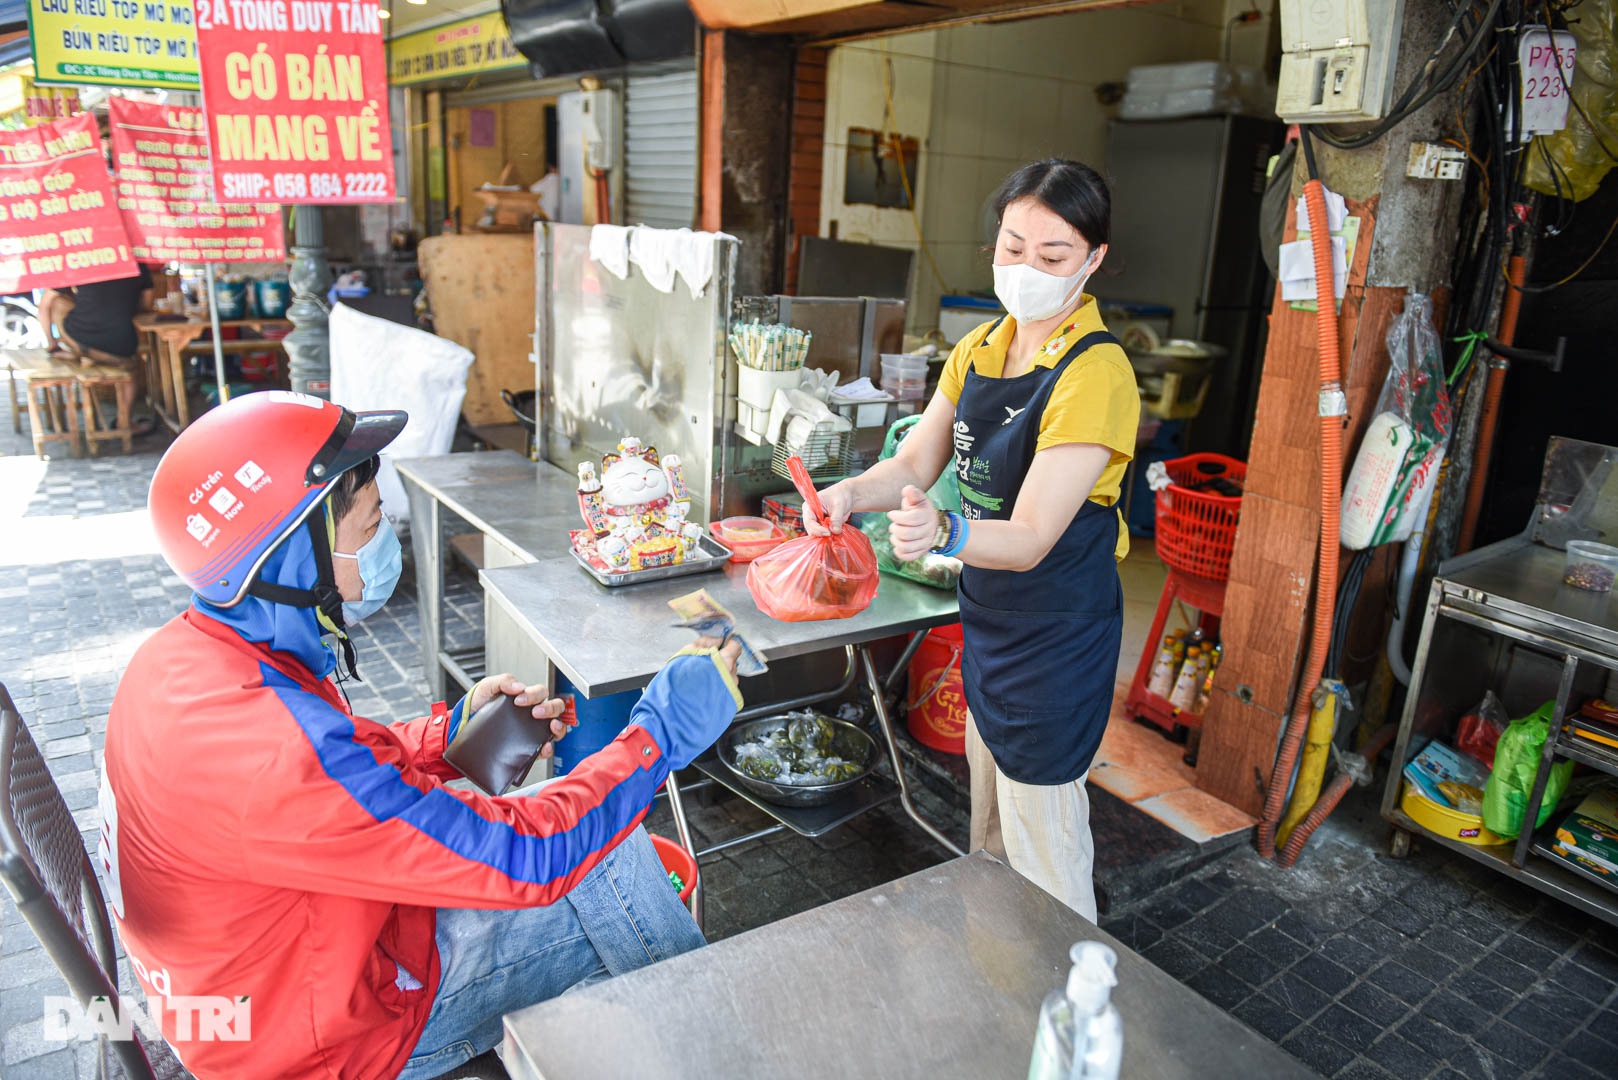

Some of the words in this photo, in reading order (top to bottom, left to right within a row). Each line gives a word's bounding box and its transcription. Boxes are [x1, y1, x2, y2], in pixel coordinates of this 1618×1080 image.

[290, 0, 333, 33] DUY
[225, 42, 278, 101] CÓ
[285, 43, 364, 102] BÁN
[215, 114, 331, 162] MANG
[335, 99, 383, 162] VỀ
[222, 172, 271, 199] SHIP:
[273, 172, 307, 199] 058
[309, 172, 342, 198] 864
[345, 172, 388, 198] 2222
[189, 487, 204, 505] Có
[201, 470, 224, 492] trên
[223, 500, 245, 522] Now
